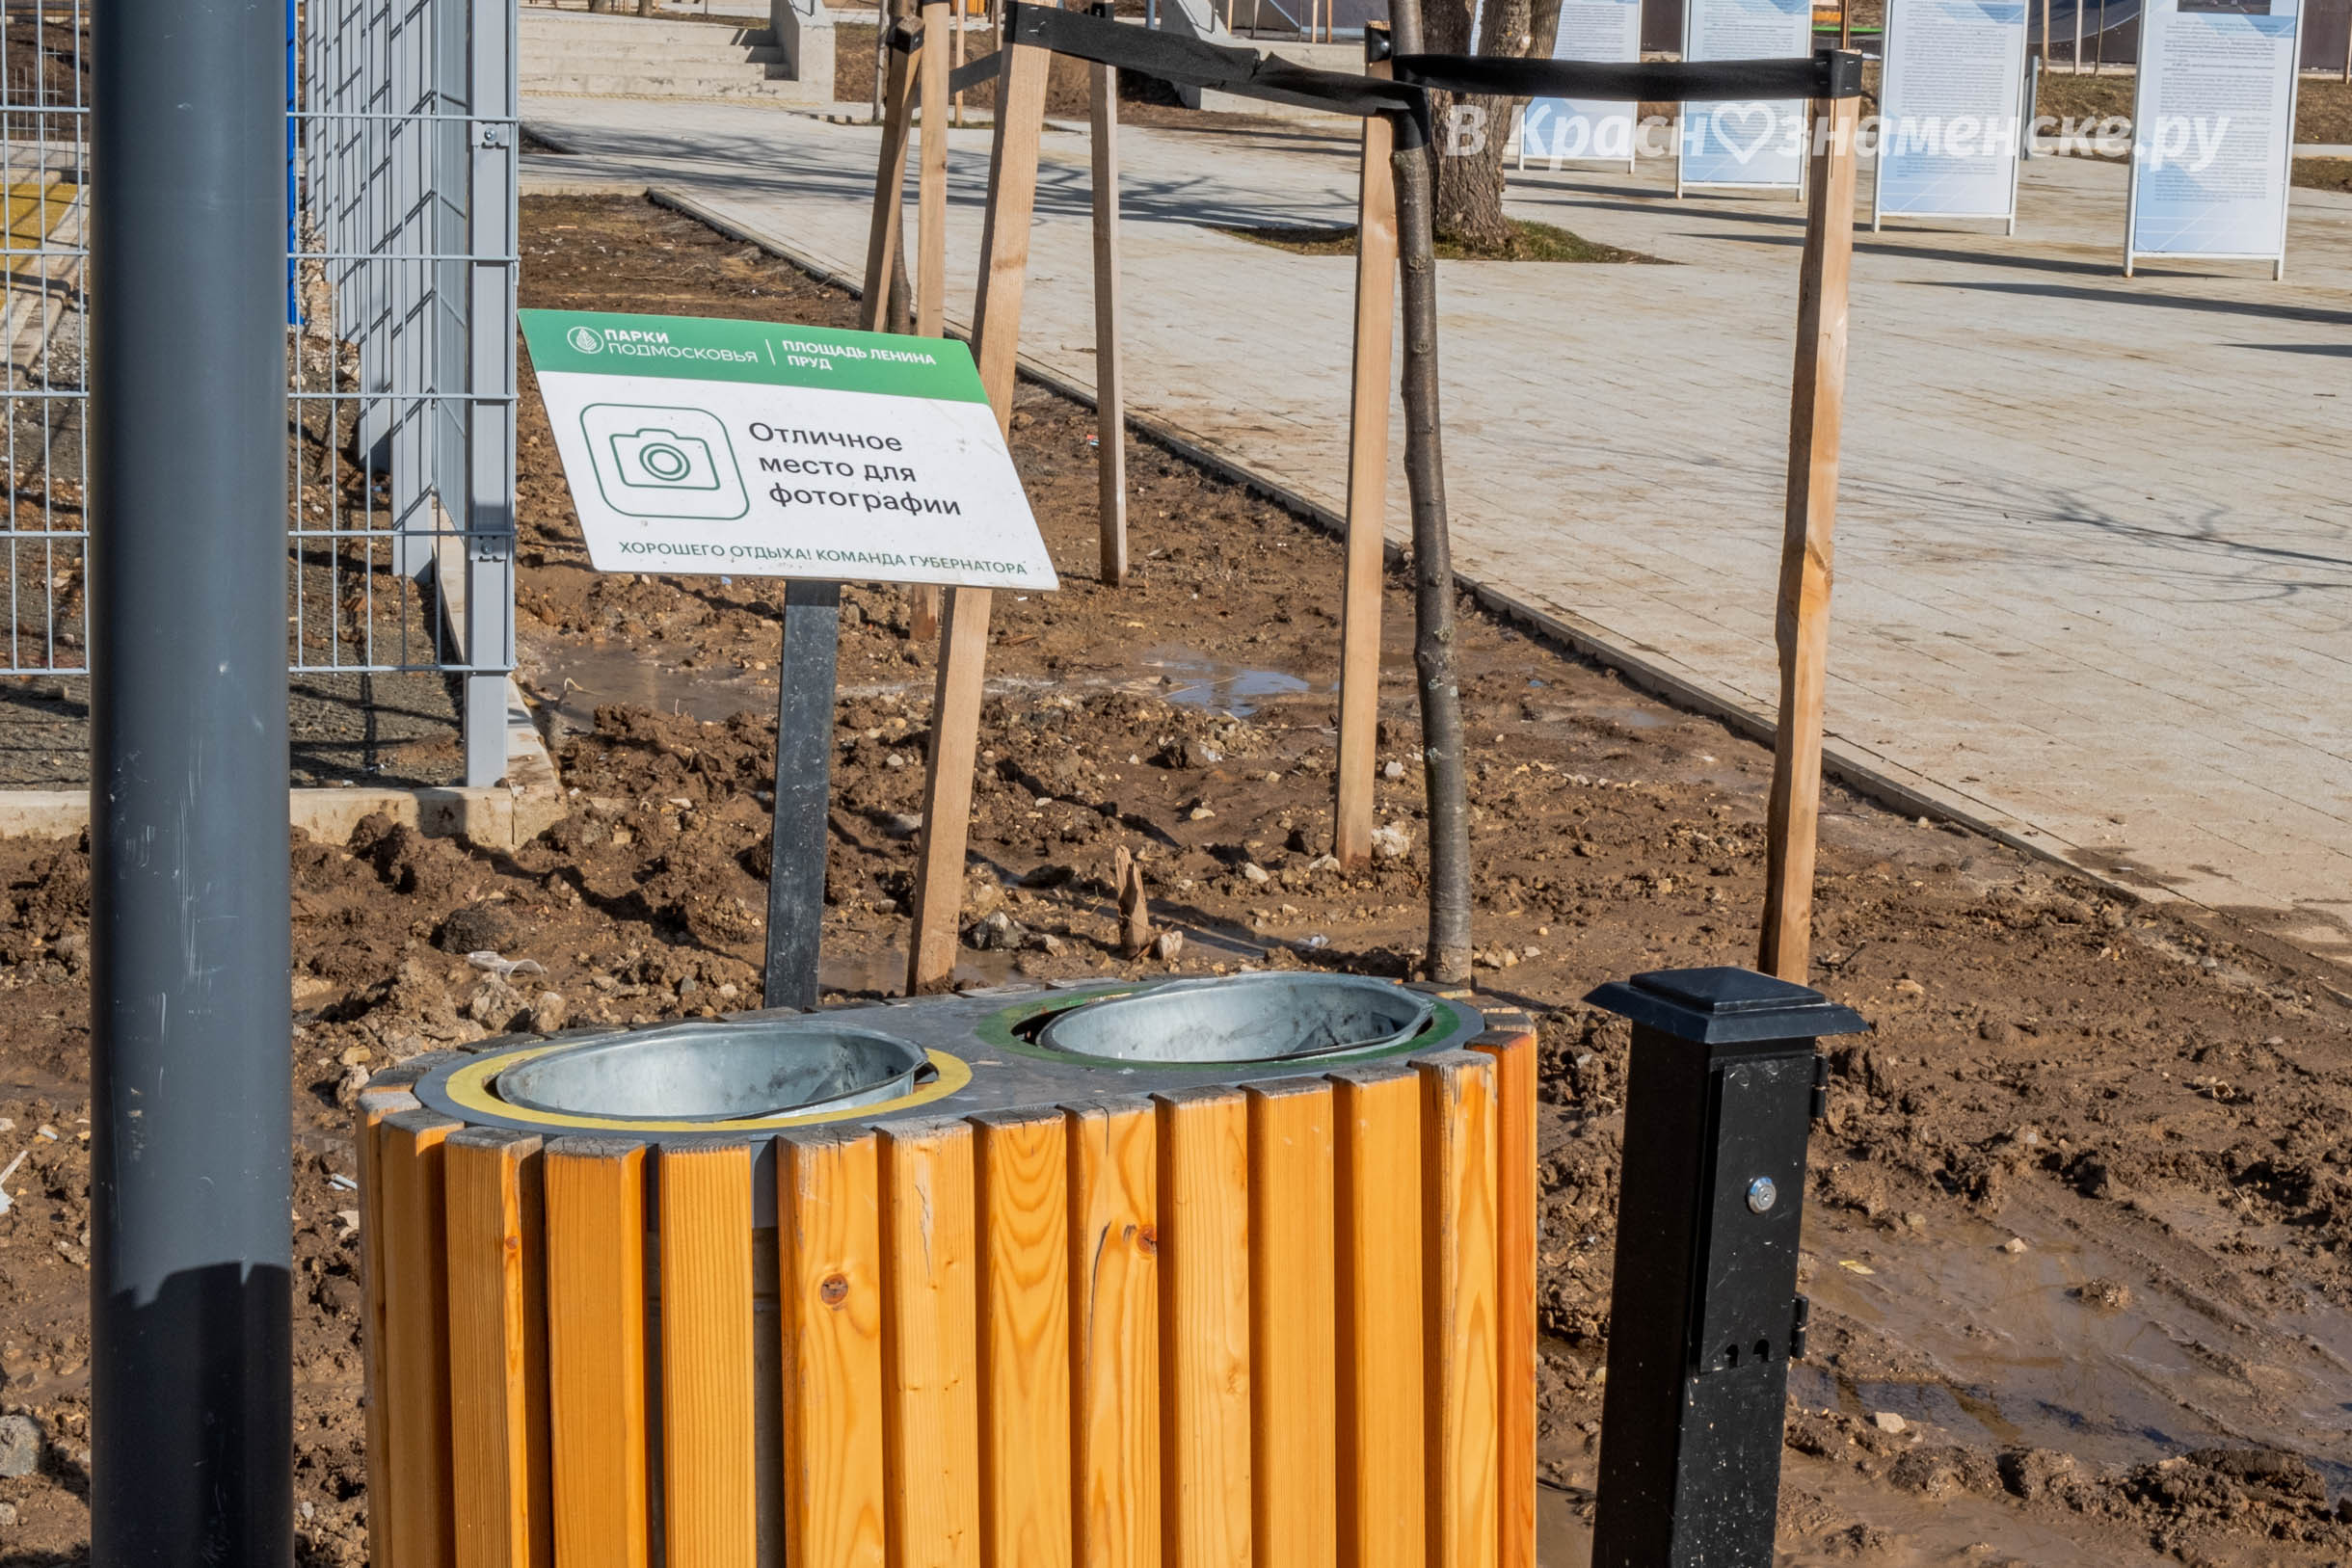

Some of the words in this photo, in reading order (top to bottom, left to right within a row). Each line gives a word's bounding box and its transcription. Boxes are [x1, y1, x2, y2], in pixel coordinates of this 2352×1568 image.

[603, 329, 670, 344] ПАРКИ
[608, 343, 759, 363] ПОДМОСКОВЬЯ
[782, 340, 868, 359] ПЛОЩАДЬ
[869, 348, 937, 365] ЛЕНИНА
[787, 355, 833, 371] ПРУД
[748, 422, 903, 452] Отличное
[759, 457, 854, 477] место
[864, 465, 917, 483] для
[768, 482, 962, 517] фотографии
[618, 541, 726, 558] ХОРОШЕГО
[730, 545, 813, 561] ОТДЫХА!
[815, 549, 906, 568] КОМАНДА
[909, 555, 1029, 576] ГУБЕРНАТОРА
